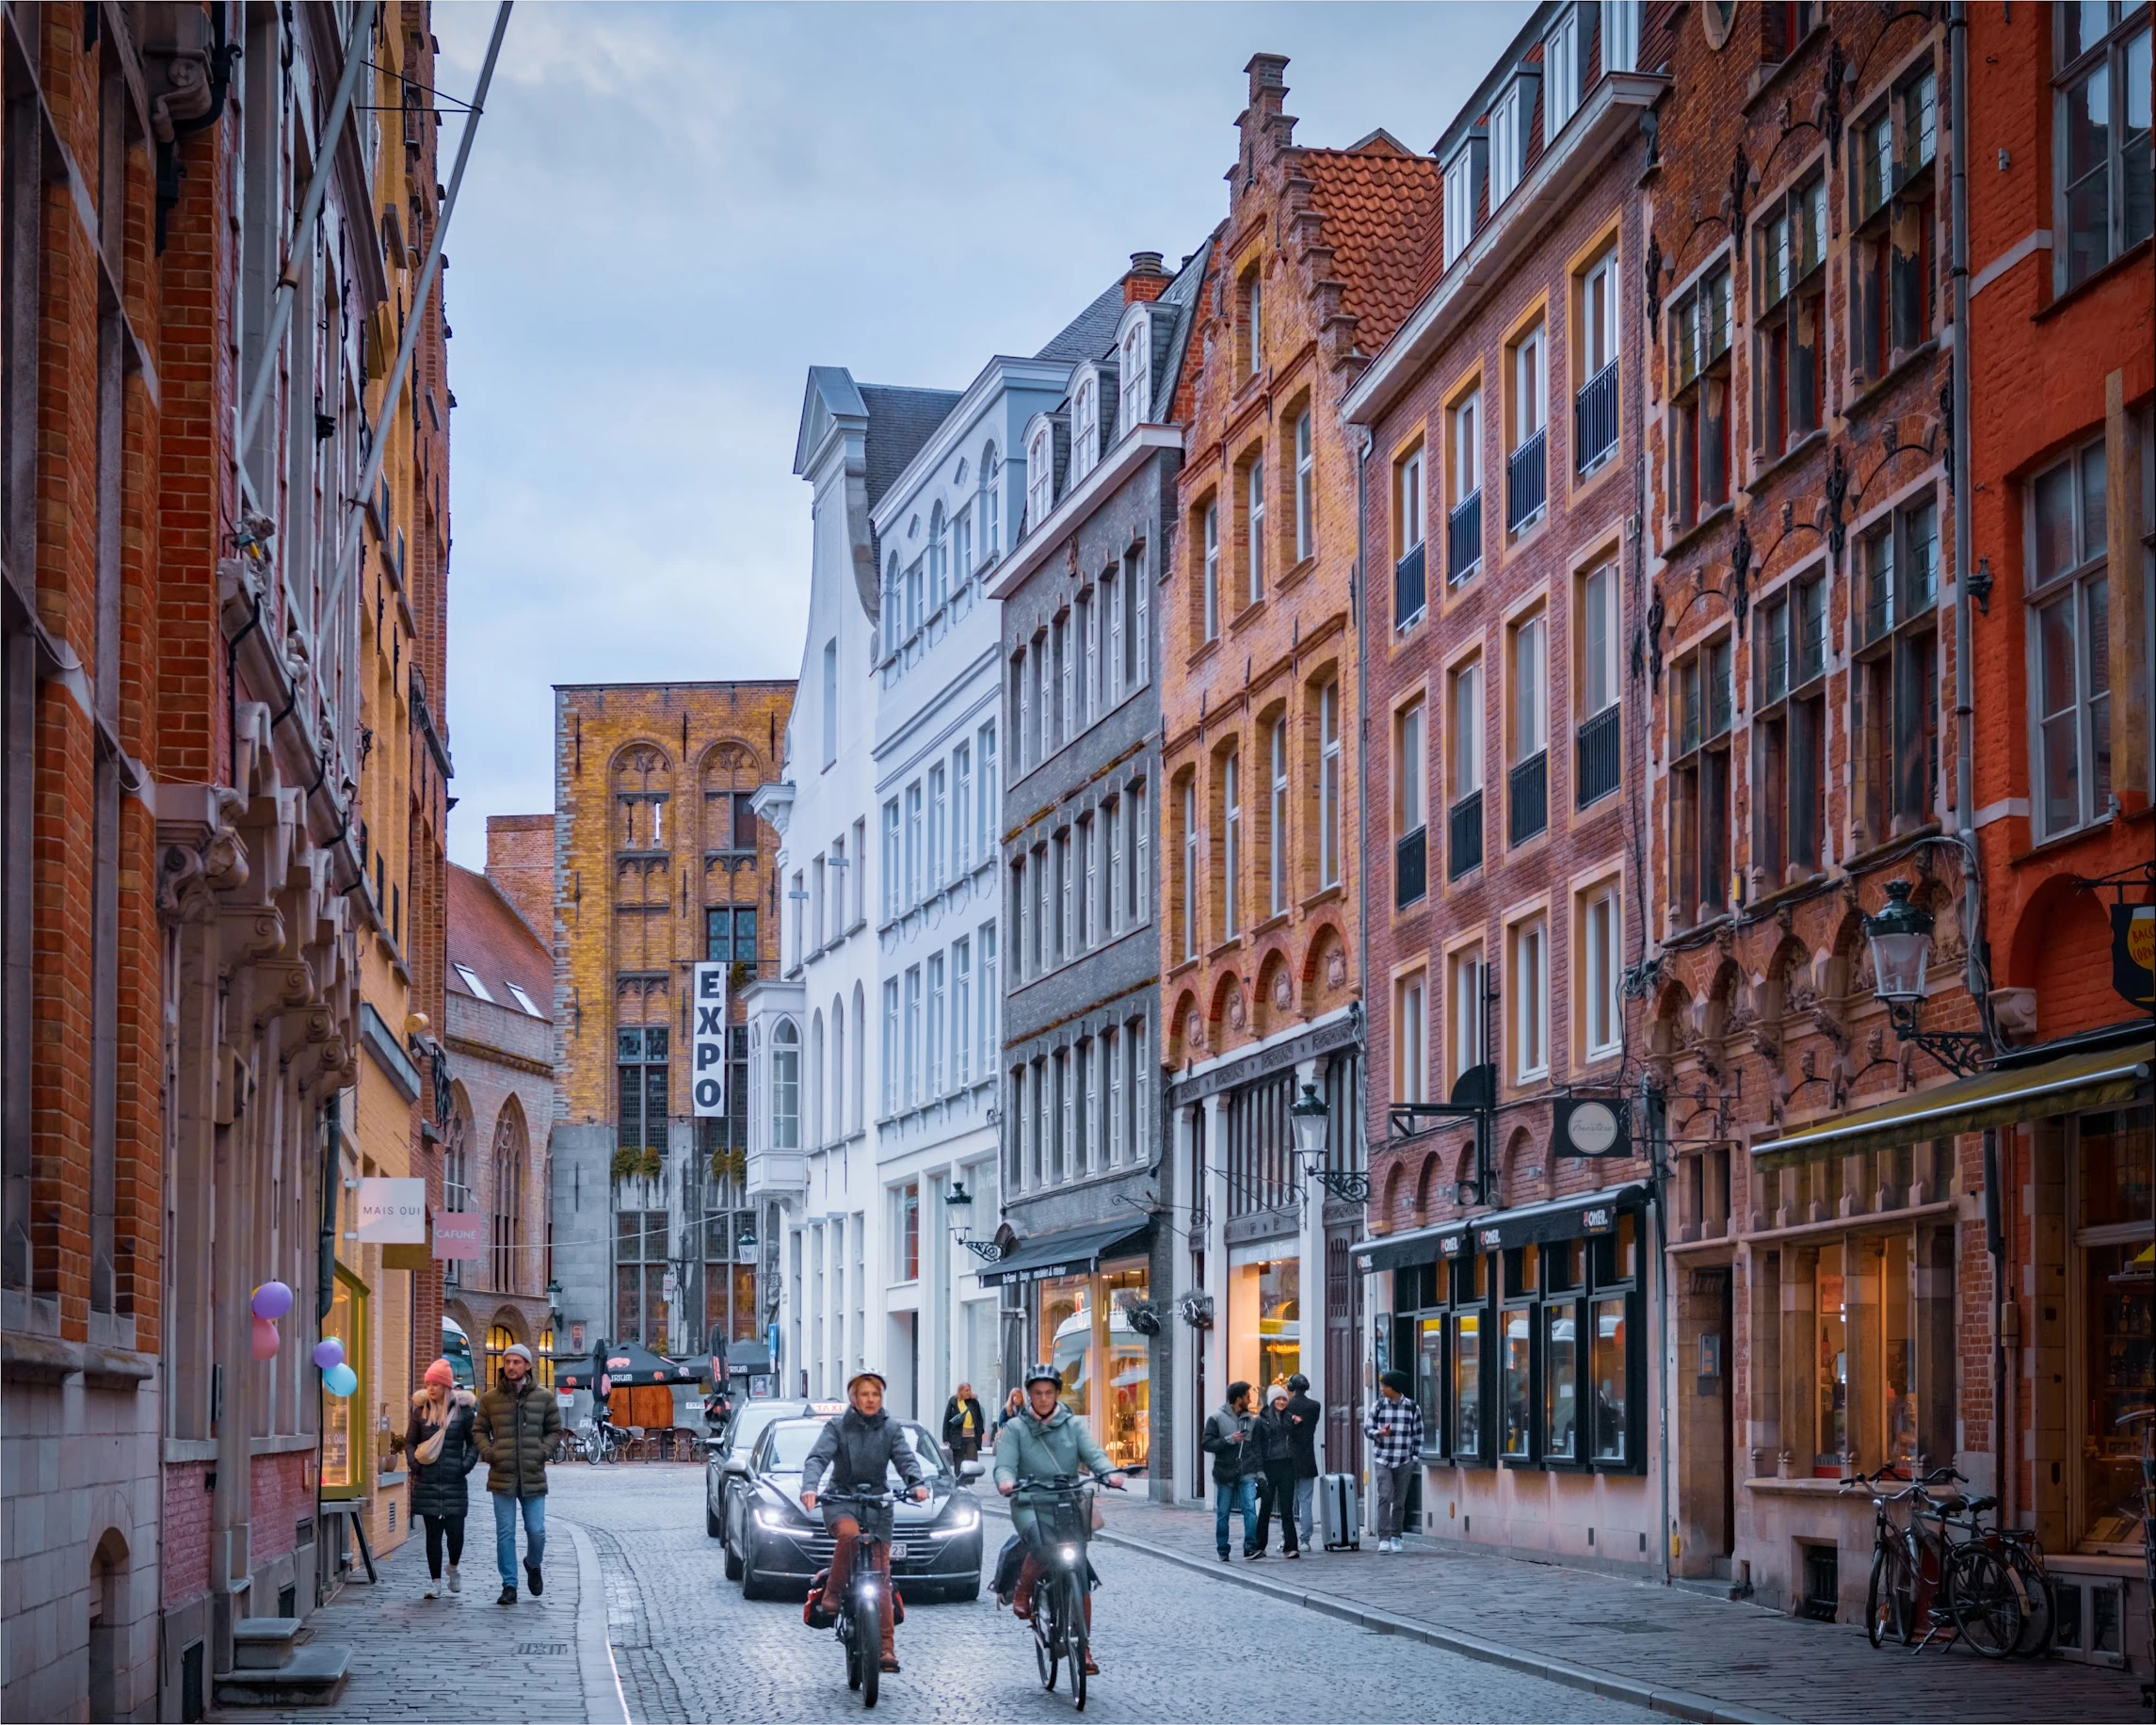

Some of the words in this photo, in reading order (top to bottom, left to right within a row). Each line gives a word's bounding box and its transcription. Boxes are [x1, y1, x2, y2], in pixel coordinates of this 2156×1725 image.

[2132, 925, 2155, 944] BACC
[695, 971, 722, 1107] EXPO
[363, 1206, 394, 1215] MAIS
[399, 1206, 421, 1216] OUI
